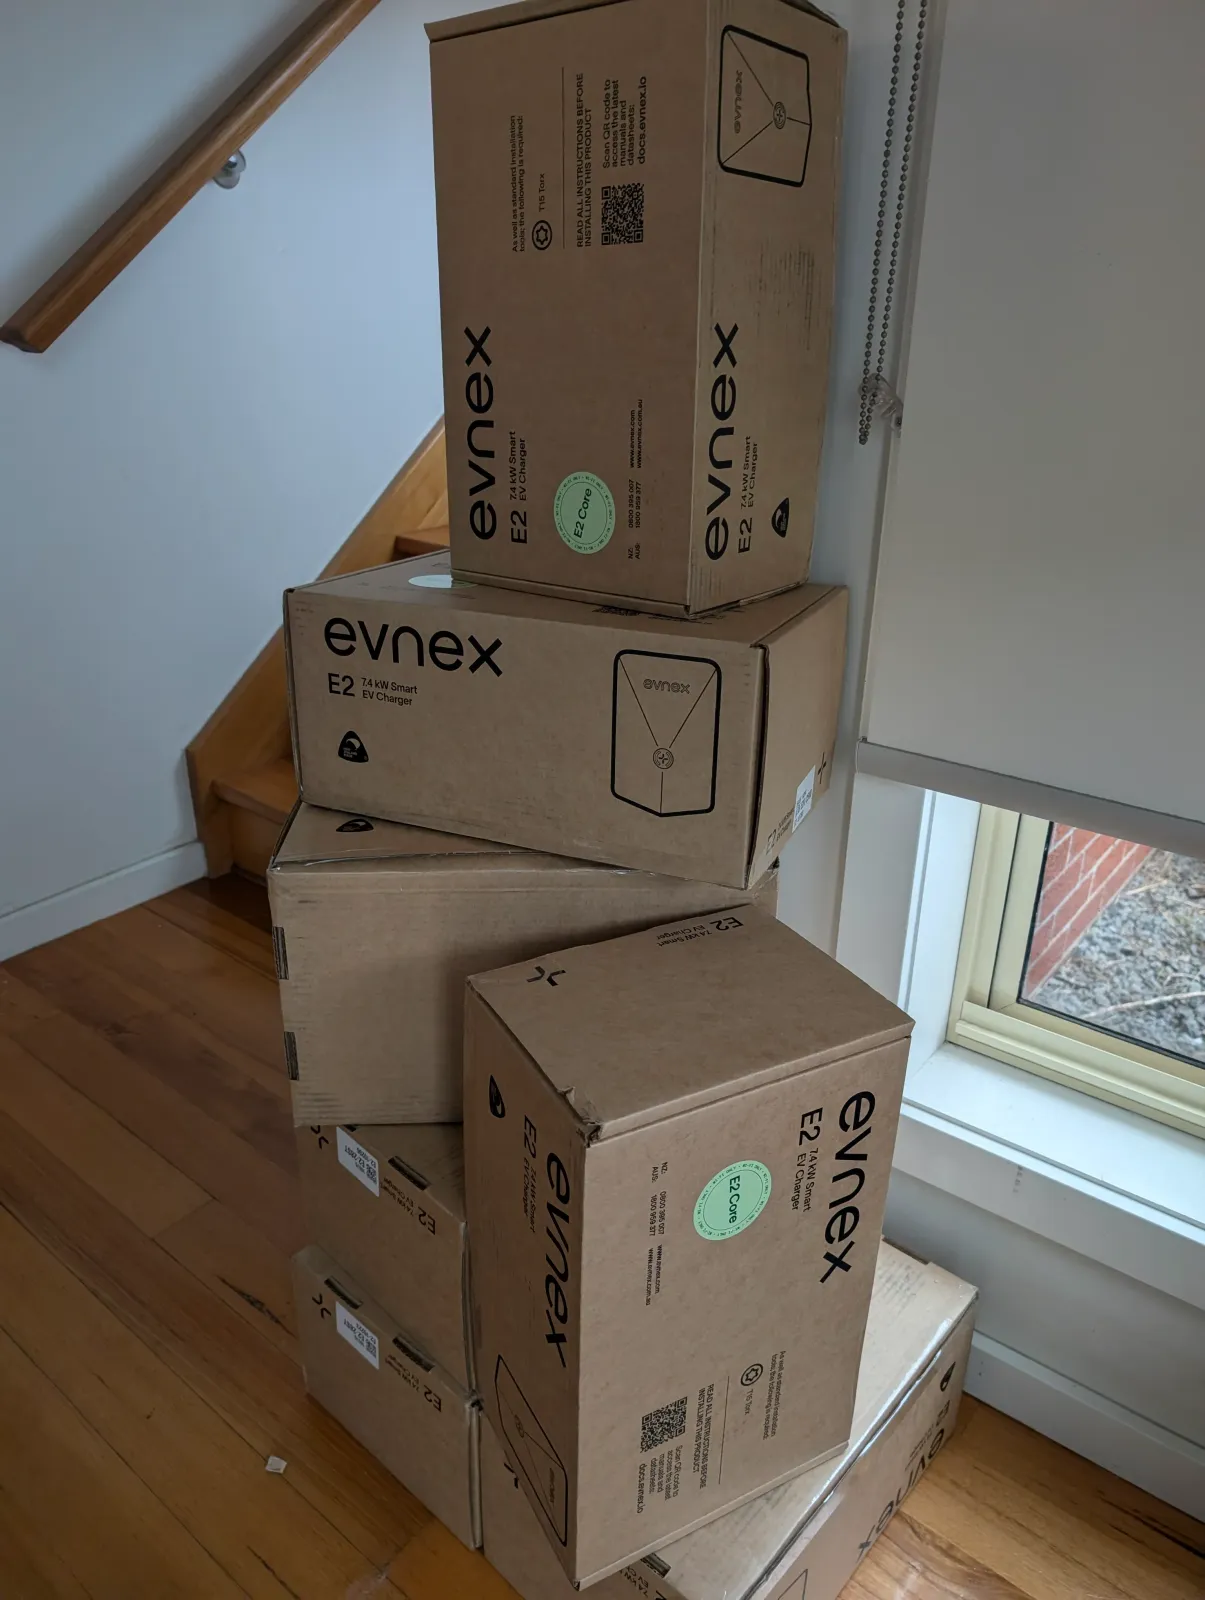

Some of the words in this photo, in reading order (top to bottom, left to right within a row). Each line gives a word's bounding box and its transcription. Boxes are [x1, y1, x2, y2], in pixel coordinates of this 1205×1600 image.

[604, 79, 611, 90] to
[611, 79, 619, 109] latest
[603, 92, 611, 120] code
[602, 122, 610, 140] QR
[637, 76, 647, 165] docs.evnex.io
[626, 104, 635, 166] datasheets:
[512, 208, 517, 219] as
[538, 195, 546, 212] T15
[512, 240, 518, 252] As
[464, 325, 497, 540] evnex
[705, 322, 739, 561] evnex
[509, 430, 517, 465] Smart
[519, 438, 527, 484] Charger
[509, 466, 517, 485] kW
[749, 442, 758, 490] Charger
[509, 487, 517, 501] 7.4
[520, 486, 527, 501] EV
[741, 473, 749, 492] kW
[578, 488, 592, 520] Core
[748, 492, 754, 508] EV
[510, 510, 528, 544] E2
[574, 521, 584, 539] E2
[737, 517, 752, 554] E2
[323, 617, 503, 677] evnex
[327, 672, 356, 697] E2
[361, 677, 373, 688] 7.4
[374, 680, 389, 690] kW
[390, 682, 418, 695] Smart
[362, 690, 374, 700] EV
[376, 692, 413, 706] Charger
[643, 678, 691, 694] evnex
[656, 928, 692, 940] Charger
[709, 917, 744, 931] E2
[656, 937, 685, 947] Smart
[524, 1114, 536, 1159] E2
[799, 1107, 823, 1146] E2
[797, 1153, 806, 1166] EV
[809, 1148, 818, 1162] 7.4
[729, 1175, 740, 1193] E2
[807, 1163, 816, 1180] kW
[522, 1173, 530, 1217] Charger
[791, 1170, 804, 1210] Charger
[803, 1182, 815, 1212] Smart
[820, 1091, 875, 1283] evnex
[418, 1206, 436, 1235] E2
[729, 1194, 740, 1223] Core
[545, 1152, 570, 1367] evnex
[424, 1385, 441, 1412] E2
[696, 1388, 705, 1427] INSTALLING
[702, 1416, 711, 1464] INSTRUCTIONS
[675, 1462, 681, 1473] QR
[693, 1442, 701, 1473] PRODUCT
[637, 1464, 647, 1513] docs.evnex.io
